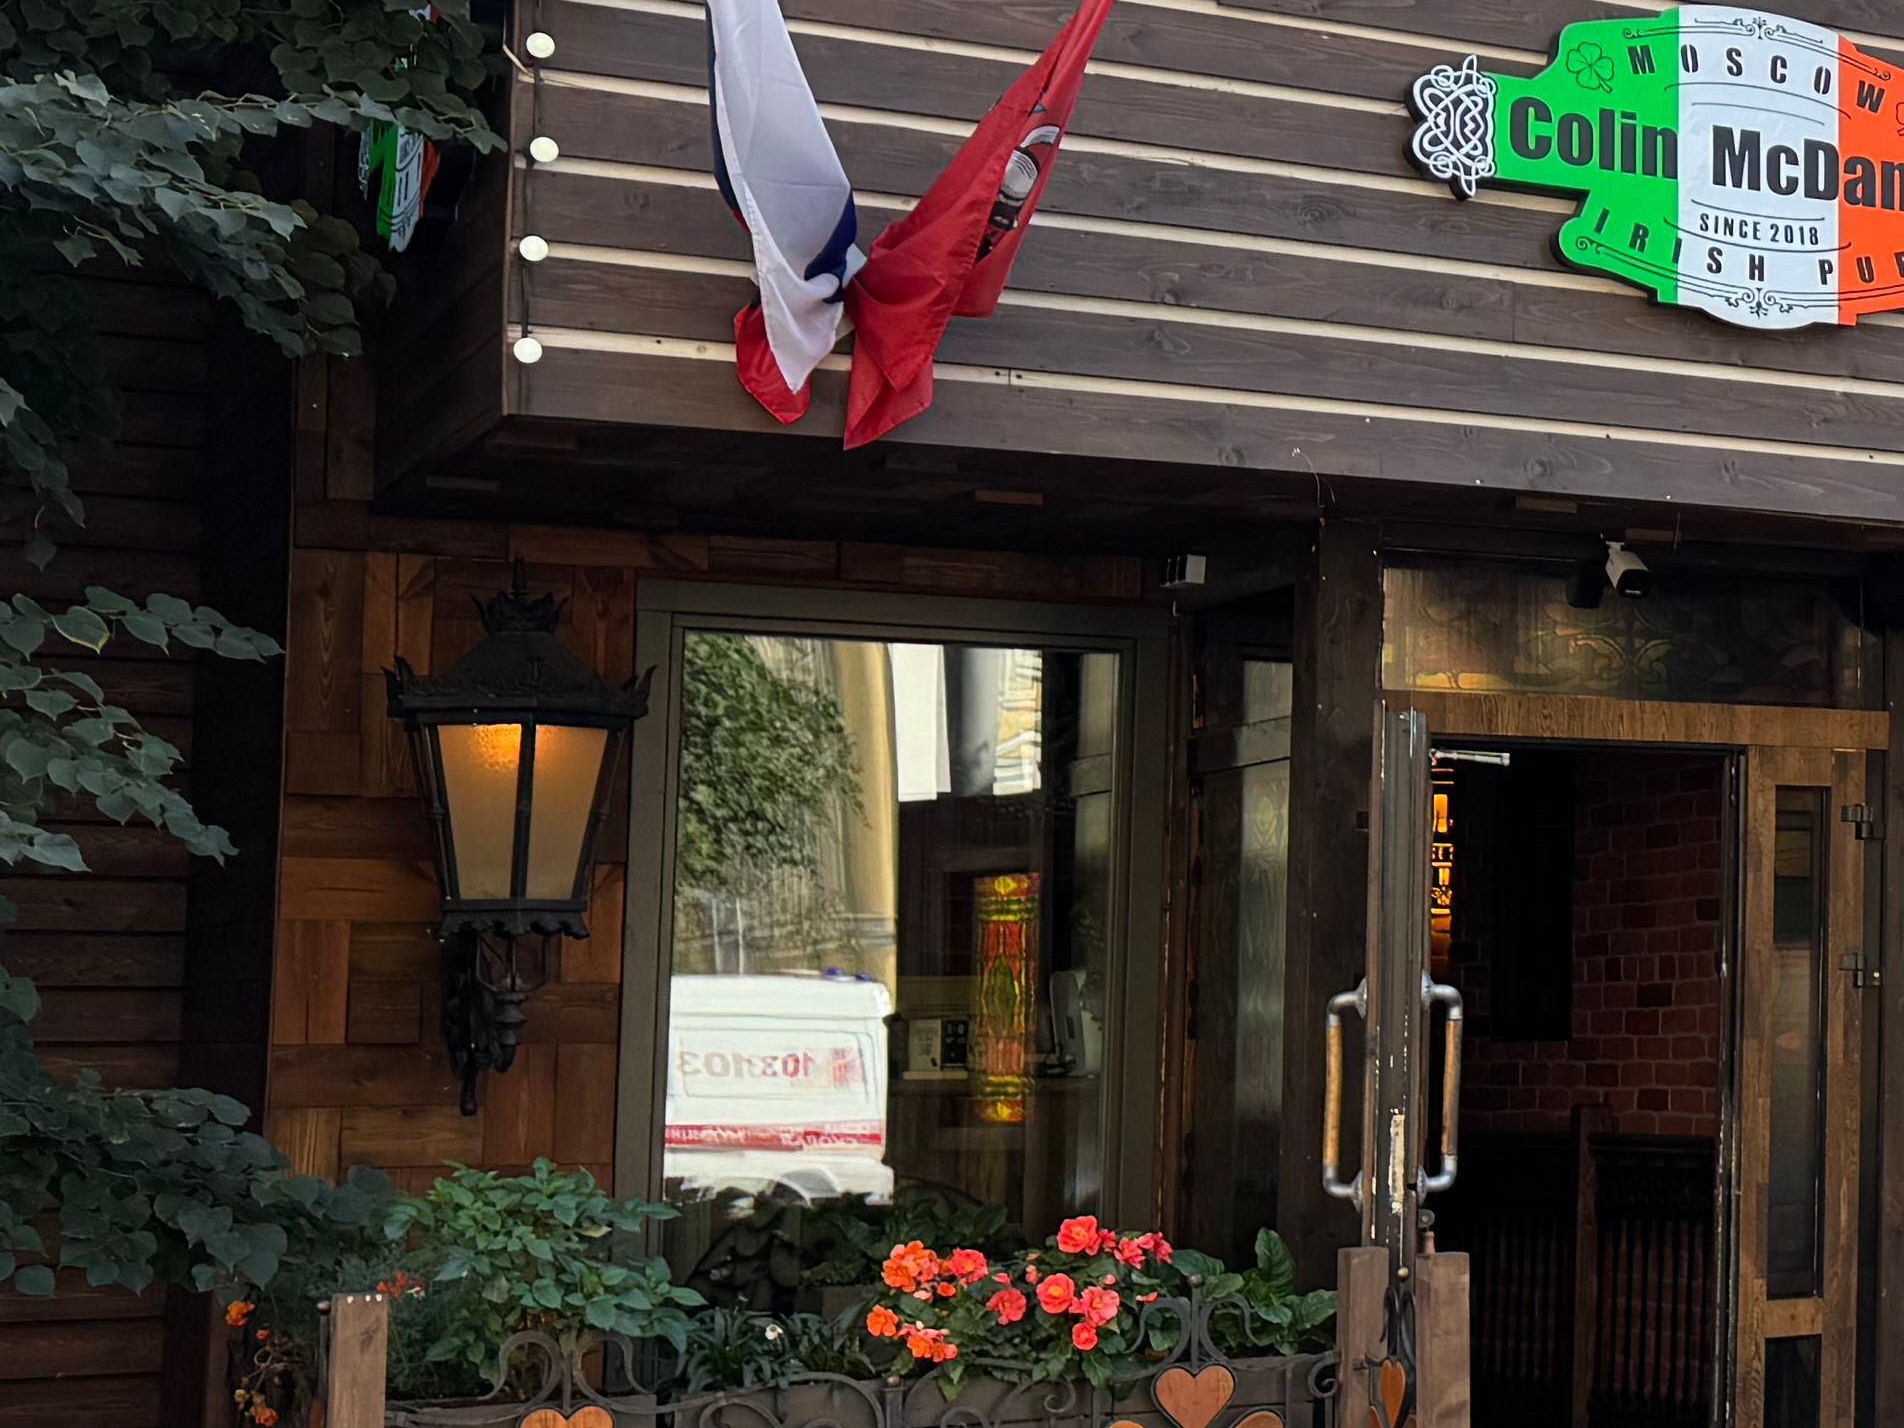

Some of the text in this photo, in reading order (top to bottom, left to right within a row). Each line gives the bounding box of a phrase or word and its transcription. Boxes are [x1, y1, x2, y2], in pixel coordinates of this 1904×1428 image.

[1627, 43, 1887, 114] MOSCOW
[1509, 95, 1678, 179] Colin
[1592, 207, 1765, 283] IRISH
[1699, 212, 1819, 247] SINCE 2018
